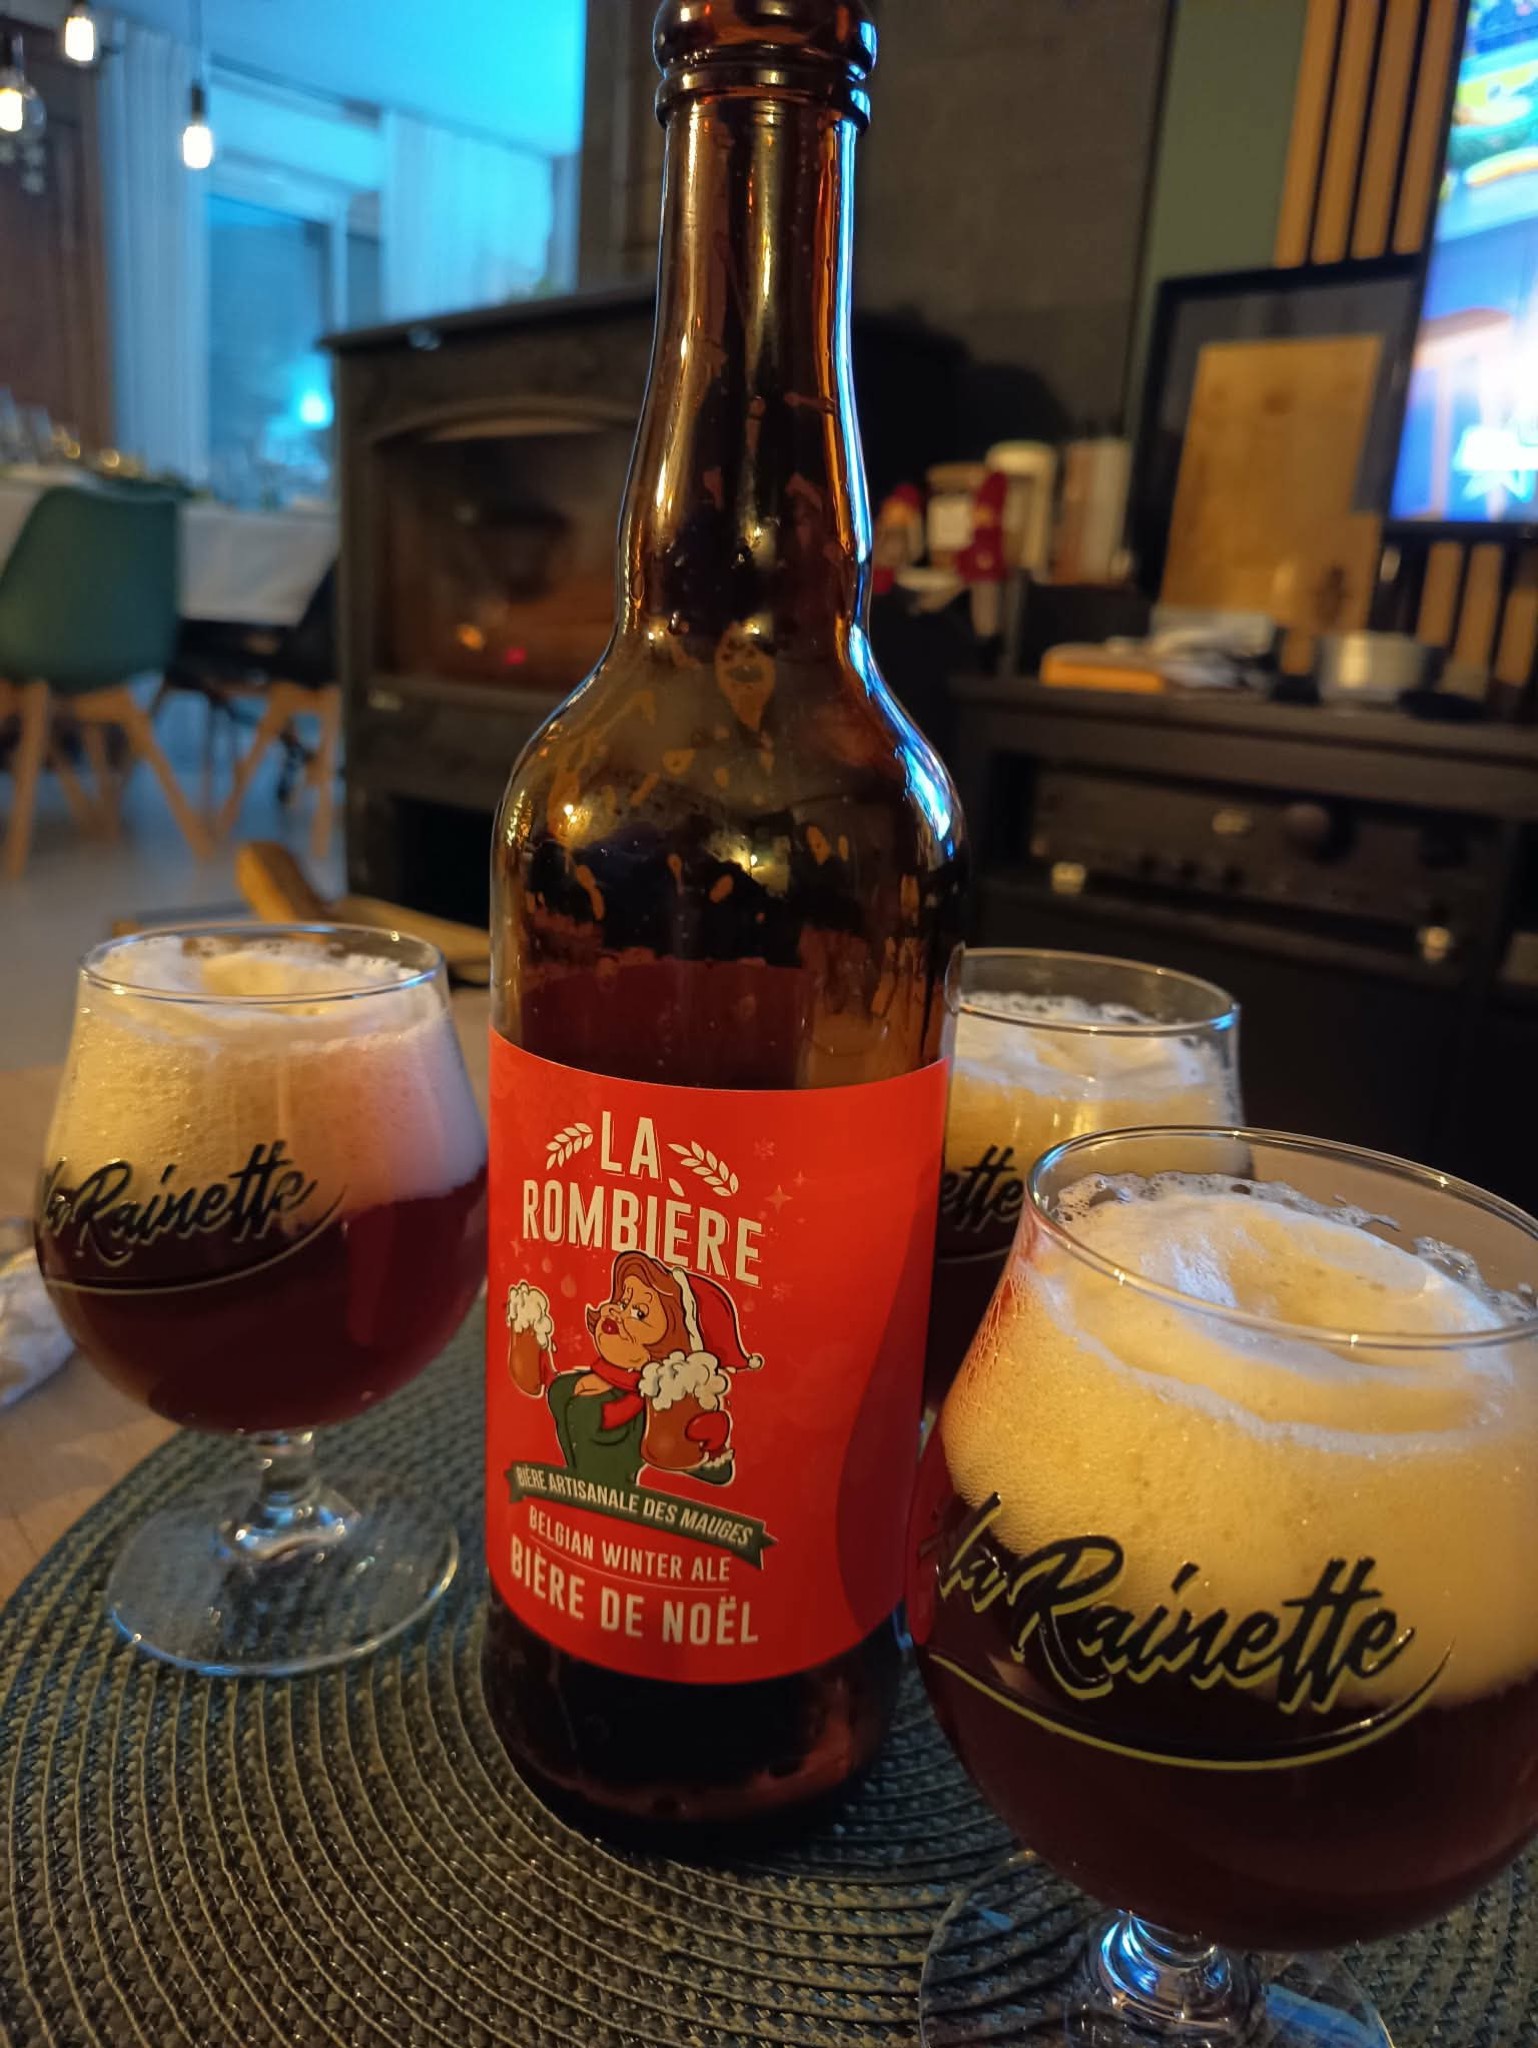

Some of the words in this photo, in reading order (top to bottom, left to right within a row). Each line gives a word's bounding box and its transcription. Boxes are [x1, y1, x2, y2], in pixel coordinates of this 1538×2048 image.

[600, 1110, 662, 1182] LA
[70, 1139, 318, 1268] Rainette
[522, 1177, 763, 1288] ROMBIÈRE
[515, 1465, 548, 1492] BIÈRE
[548, 1472, 640, 1514] ARTISANALE
[642, 1498, 676, 1525] DES
[679, 1508, 754, 1547] MAUGES
[528, 1504, 595, 1561] BELGIAN
[601, 1540, 683, 1579] WINTER
[690, 1556, 732, 1582] ALE
[510, 1533, 586, 1621] BIÈRE
[600, 1586, 645, 1638] DE
[662, 1595, 759, 1646] NOËL
[1006, 1535, 1416, 1714] Rainette
